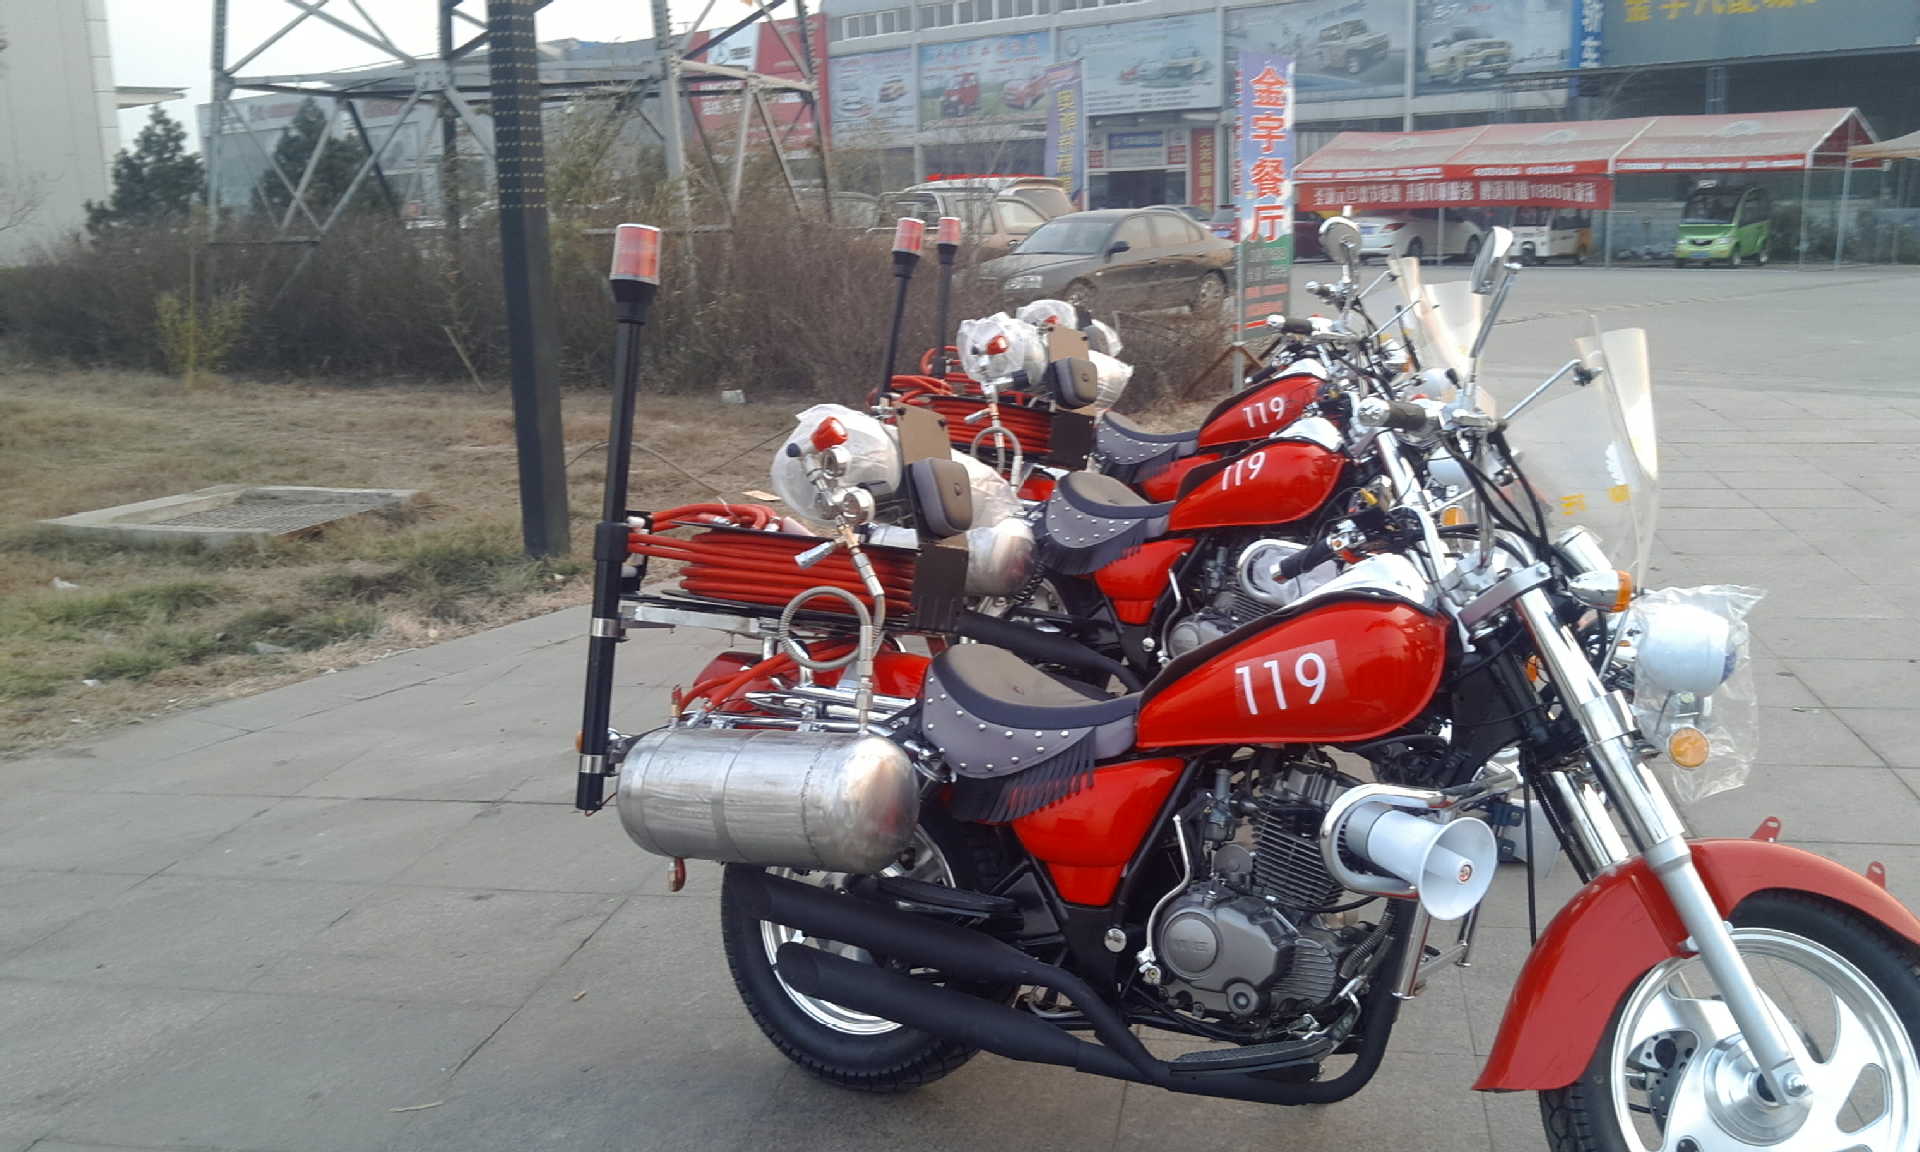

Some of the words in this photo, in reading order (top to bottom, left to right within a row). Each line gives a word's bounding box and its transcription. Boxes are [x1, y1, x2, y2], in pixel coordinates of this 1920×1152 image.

[1242, 396, 1287, 428] 119
[1220, 451, 1266, 491] 119
[1235, 652, 1327, 715] 119
